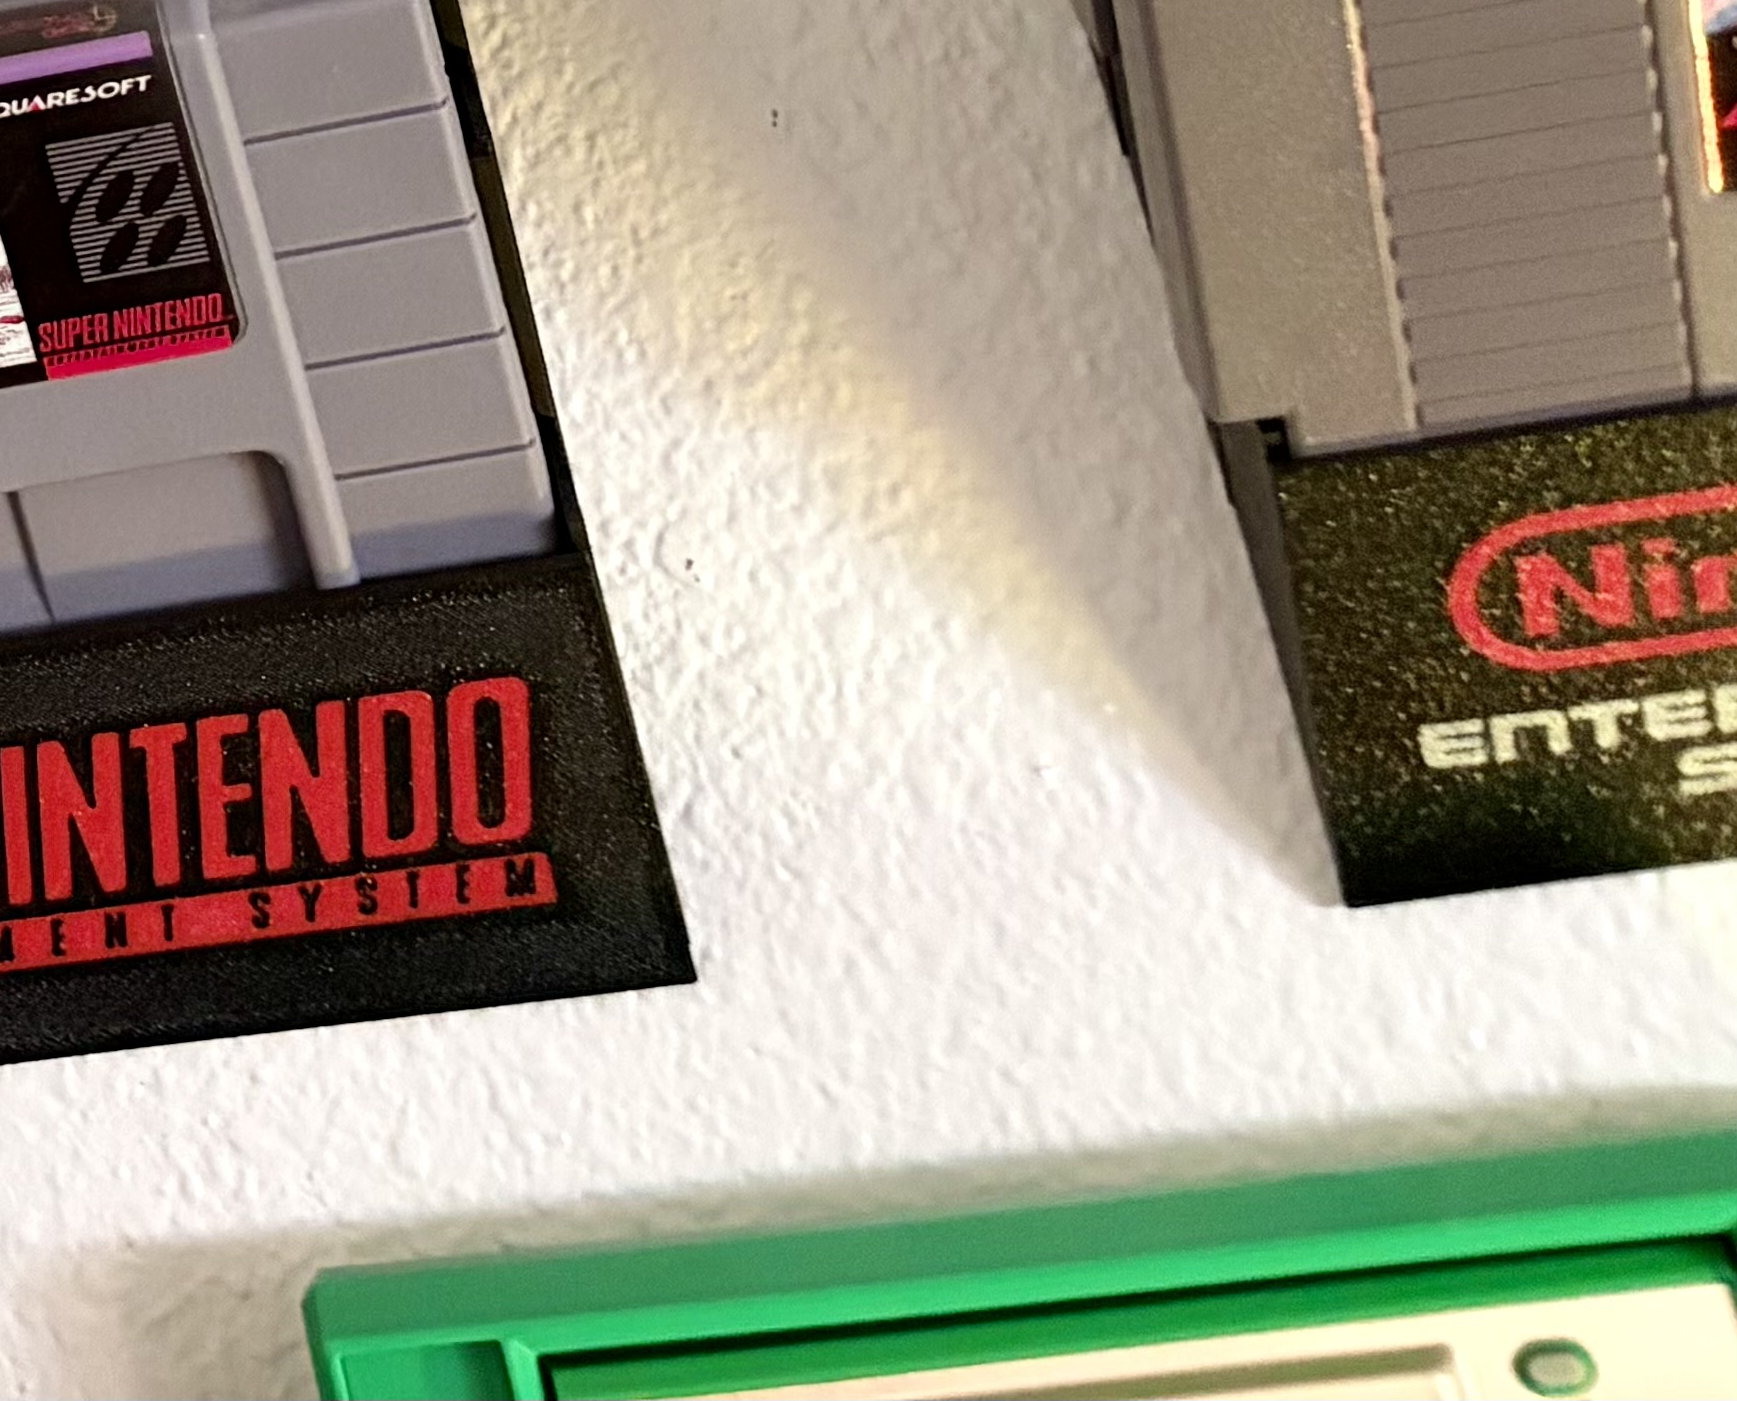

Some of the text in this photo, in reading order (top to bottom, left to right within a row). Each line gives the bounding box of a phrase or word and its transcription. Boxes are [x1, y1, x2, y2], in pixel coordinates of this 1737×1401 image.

[38, 314, 110, 353] SUPER
[112, 293, 224, 339] NINTENDO
[249, 860, 541, 932] SYSTEM
